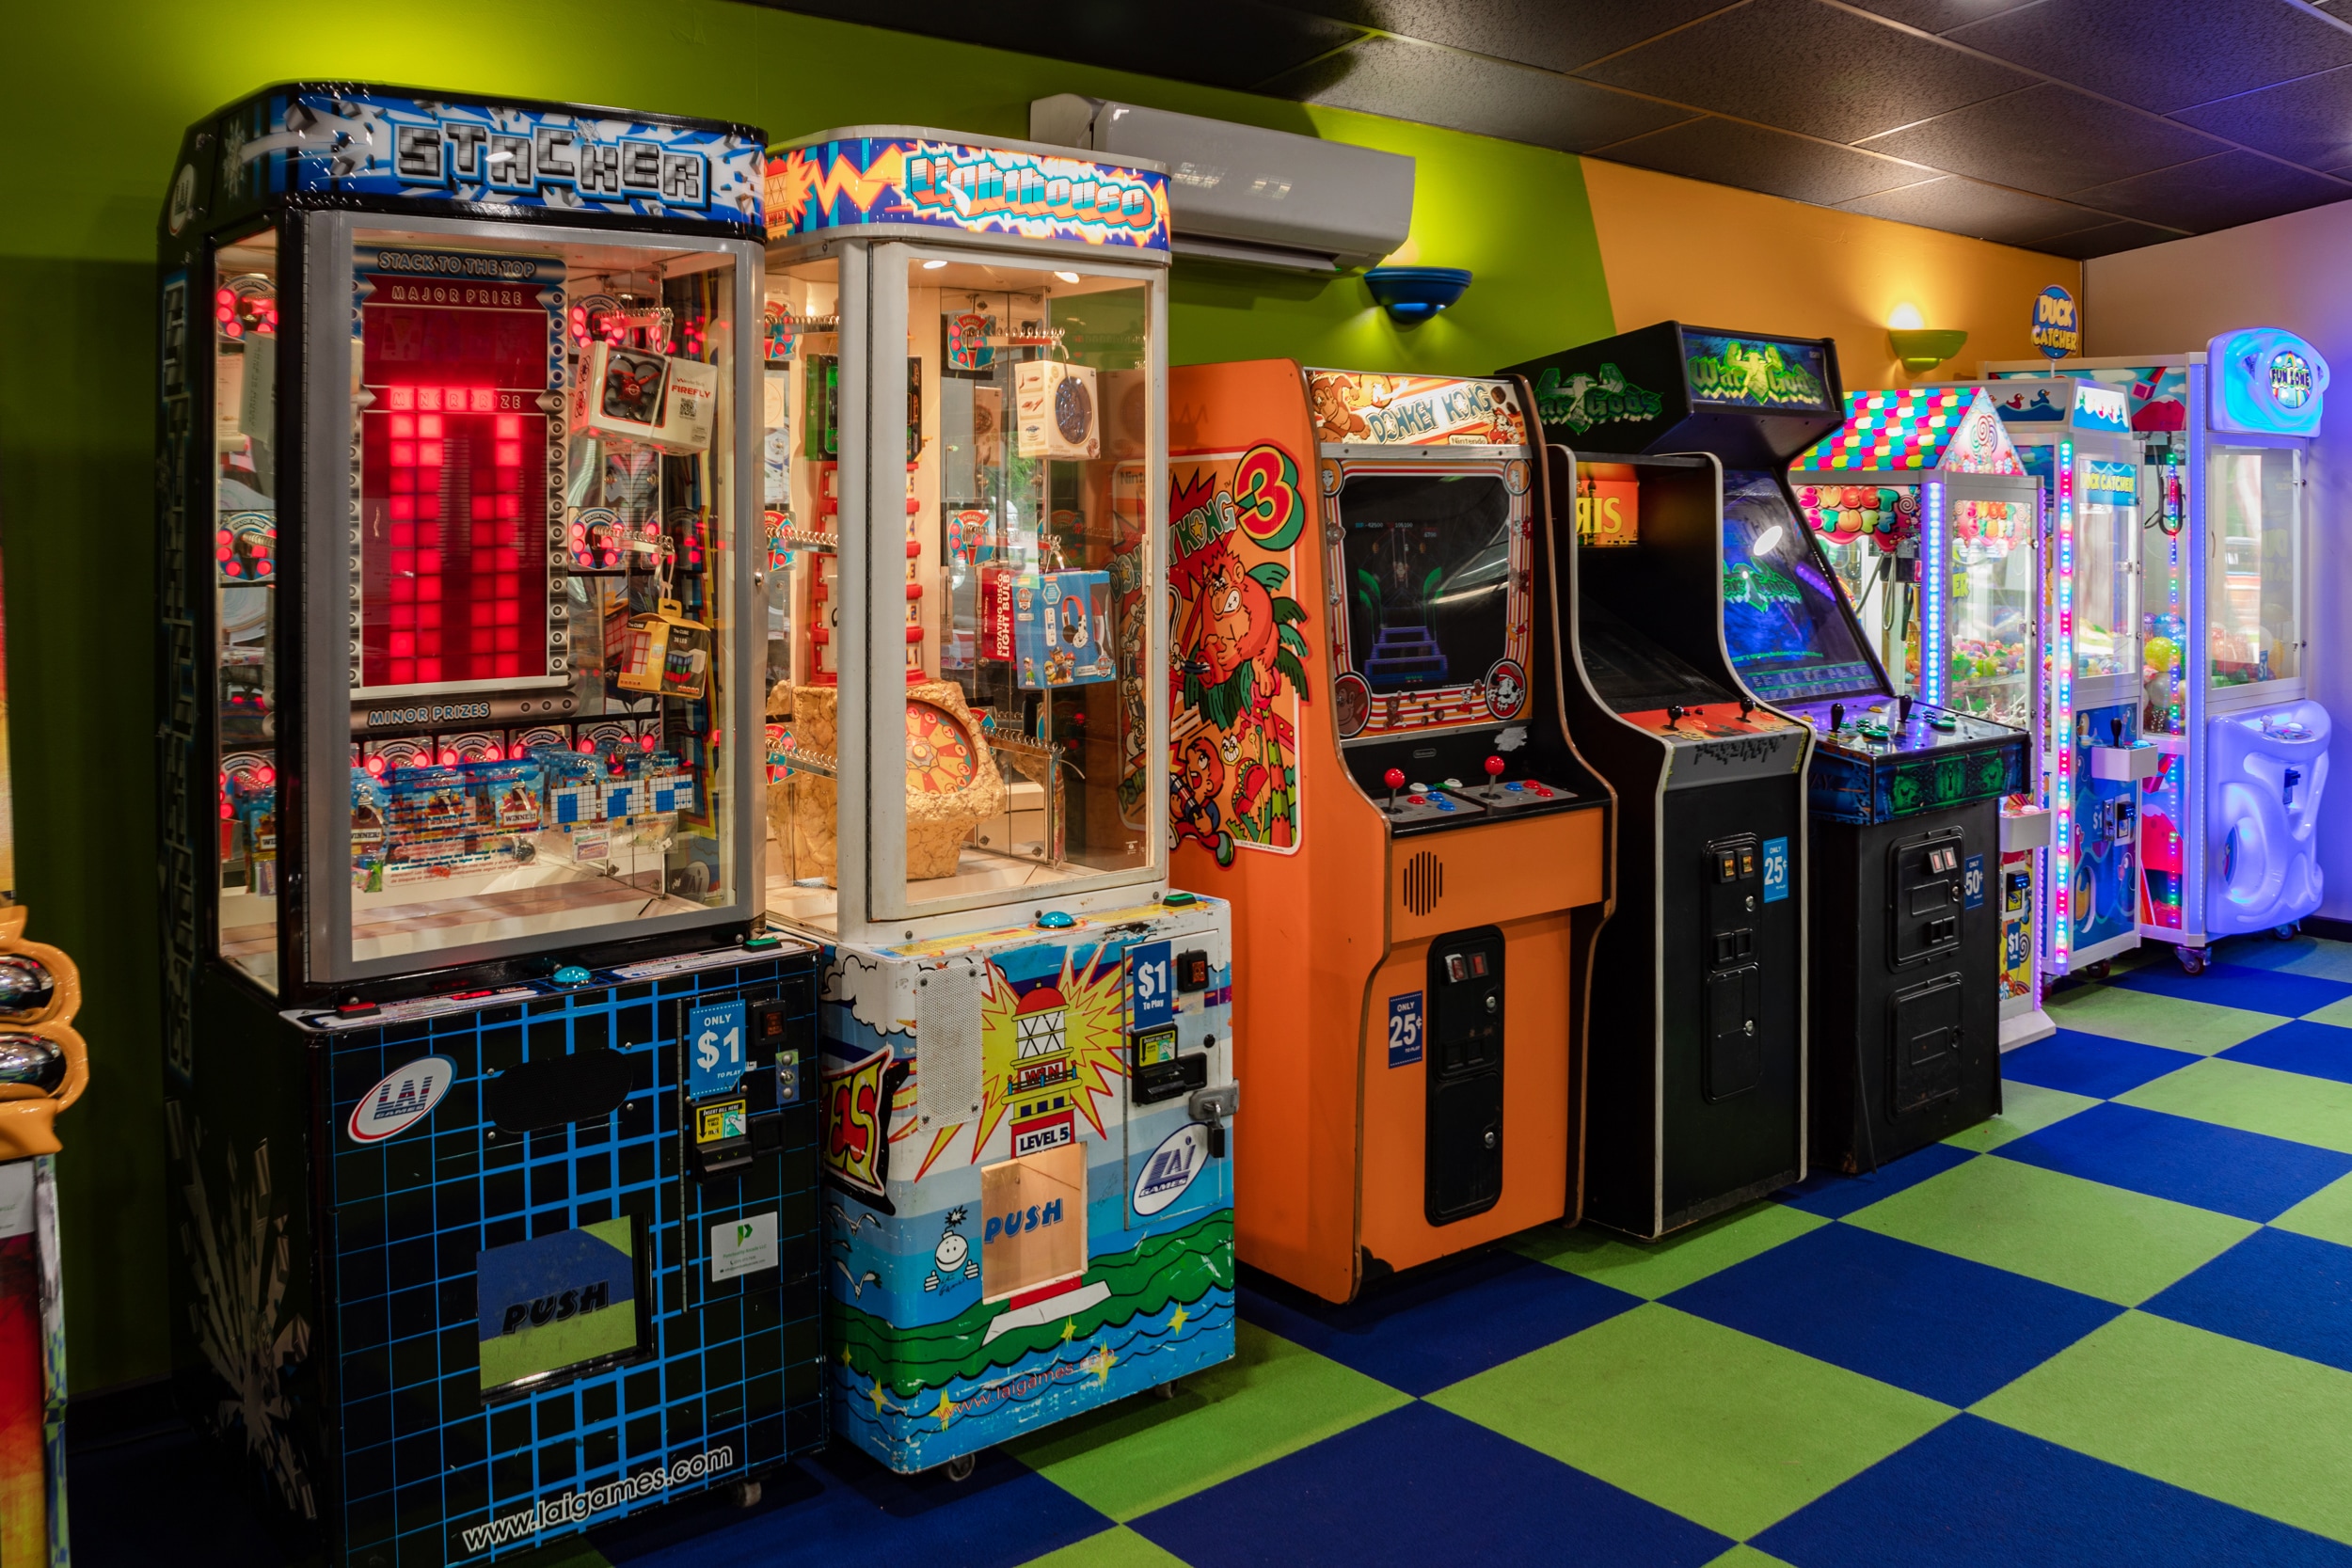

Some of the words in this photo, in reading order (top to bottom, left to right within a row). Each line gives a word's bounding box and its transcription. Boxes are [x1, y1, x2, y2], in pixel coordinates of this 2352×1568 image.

[398, 123, 699, 198] STACKER
[910, 156, 1150, 222] Lighthouse
[378, 251, 434, 271] STACK
[437, 256, 461, 273] TO
[465, 258, 498, 275] THE
[502, 261, 535, 277] TOP
[391, 286, 459, 303] MAJOR
[466, 289, 522, 305] PRIZE
[2038, 294, 2073, 327] DUCK
[2032, 325, 2077, 351] CATCHER
[2271, 368, 2287, 384] FUN
[671, 385, 710, 399] FIREFLY
[1366, 399, 1438, 444] DONKEY
[1441, 383, 1493, 424] KONG
[1535, 390, 1575, 424] ar
[1176, 491, 1237, 559] KONG
[1233, 444, 1304, 551] 3
[1797, 485, 1899, 513] SWEET
[1967, 500, 2016, 519] SWEET
[1804, 508, 1897, 533] STUFF
[369, 706, 428, 726] MINOR
[432, 703, 490, 721] PRIZES
[1764, 856, 1788, 885] 25¢
[1965, 869, 1983, 896] 50¢
[2008, 932, 2019, 954] $1
[1137, 960, 1167, 1000] $1
[1143, 1001, 1151, 1010] To
[1151, 999, 1165, 1009] Play
[1397, 1001, 1415, 1013] ONLY
[704, 1013, 732, 1026] ONLY
[1389, 1013, 1422, 1048] 25¢
[697, 1026, 739, 1072] $1
[725, 1069, 741, 1078] PLAY
[376, 1075, 434, 1112] LAI
[727, 1104, 739, 1113] HERE
[1020, 1129, 1057, 1152] LEVEL
[1060, 1127, 1071, 1142] 5
[1139, 1178, 1188, 1197] GAMES
[984, 1197, 1063, 1244] PUSH
[502, 1279, 610, 1336] PUSH
[462, 1445, 733, 1553] www.laigames.com
